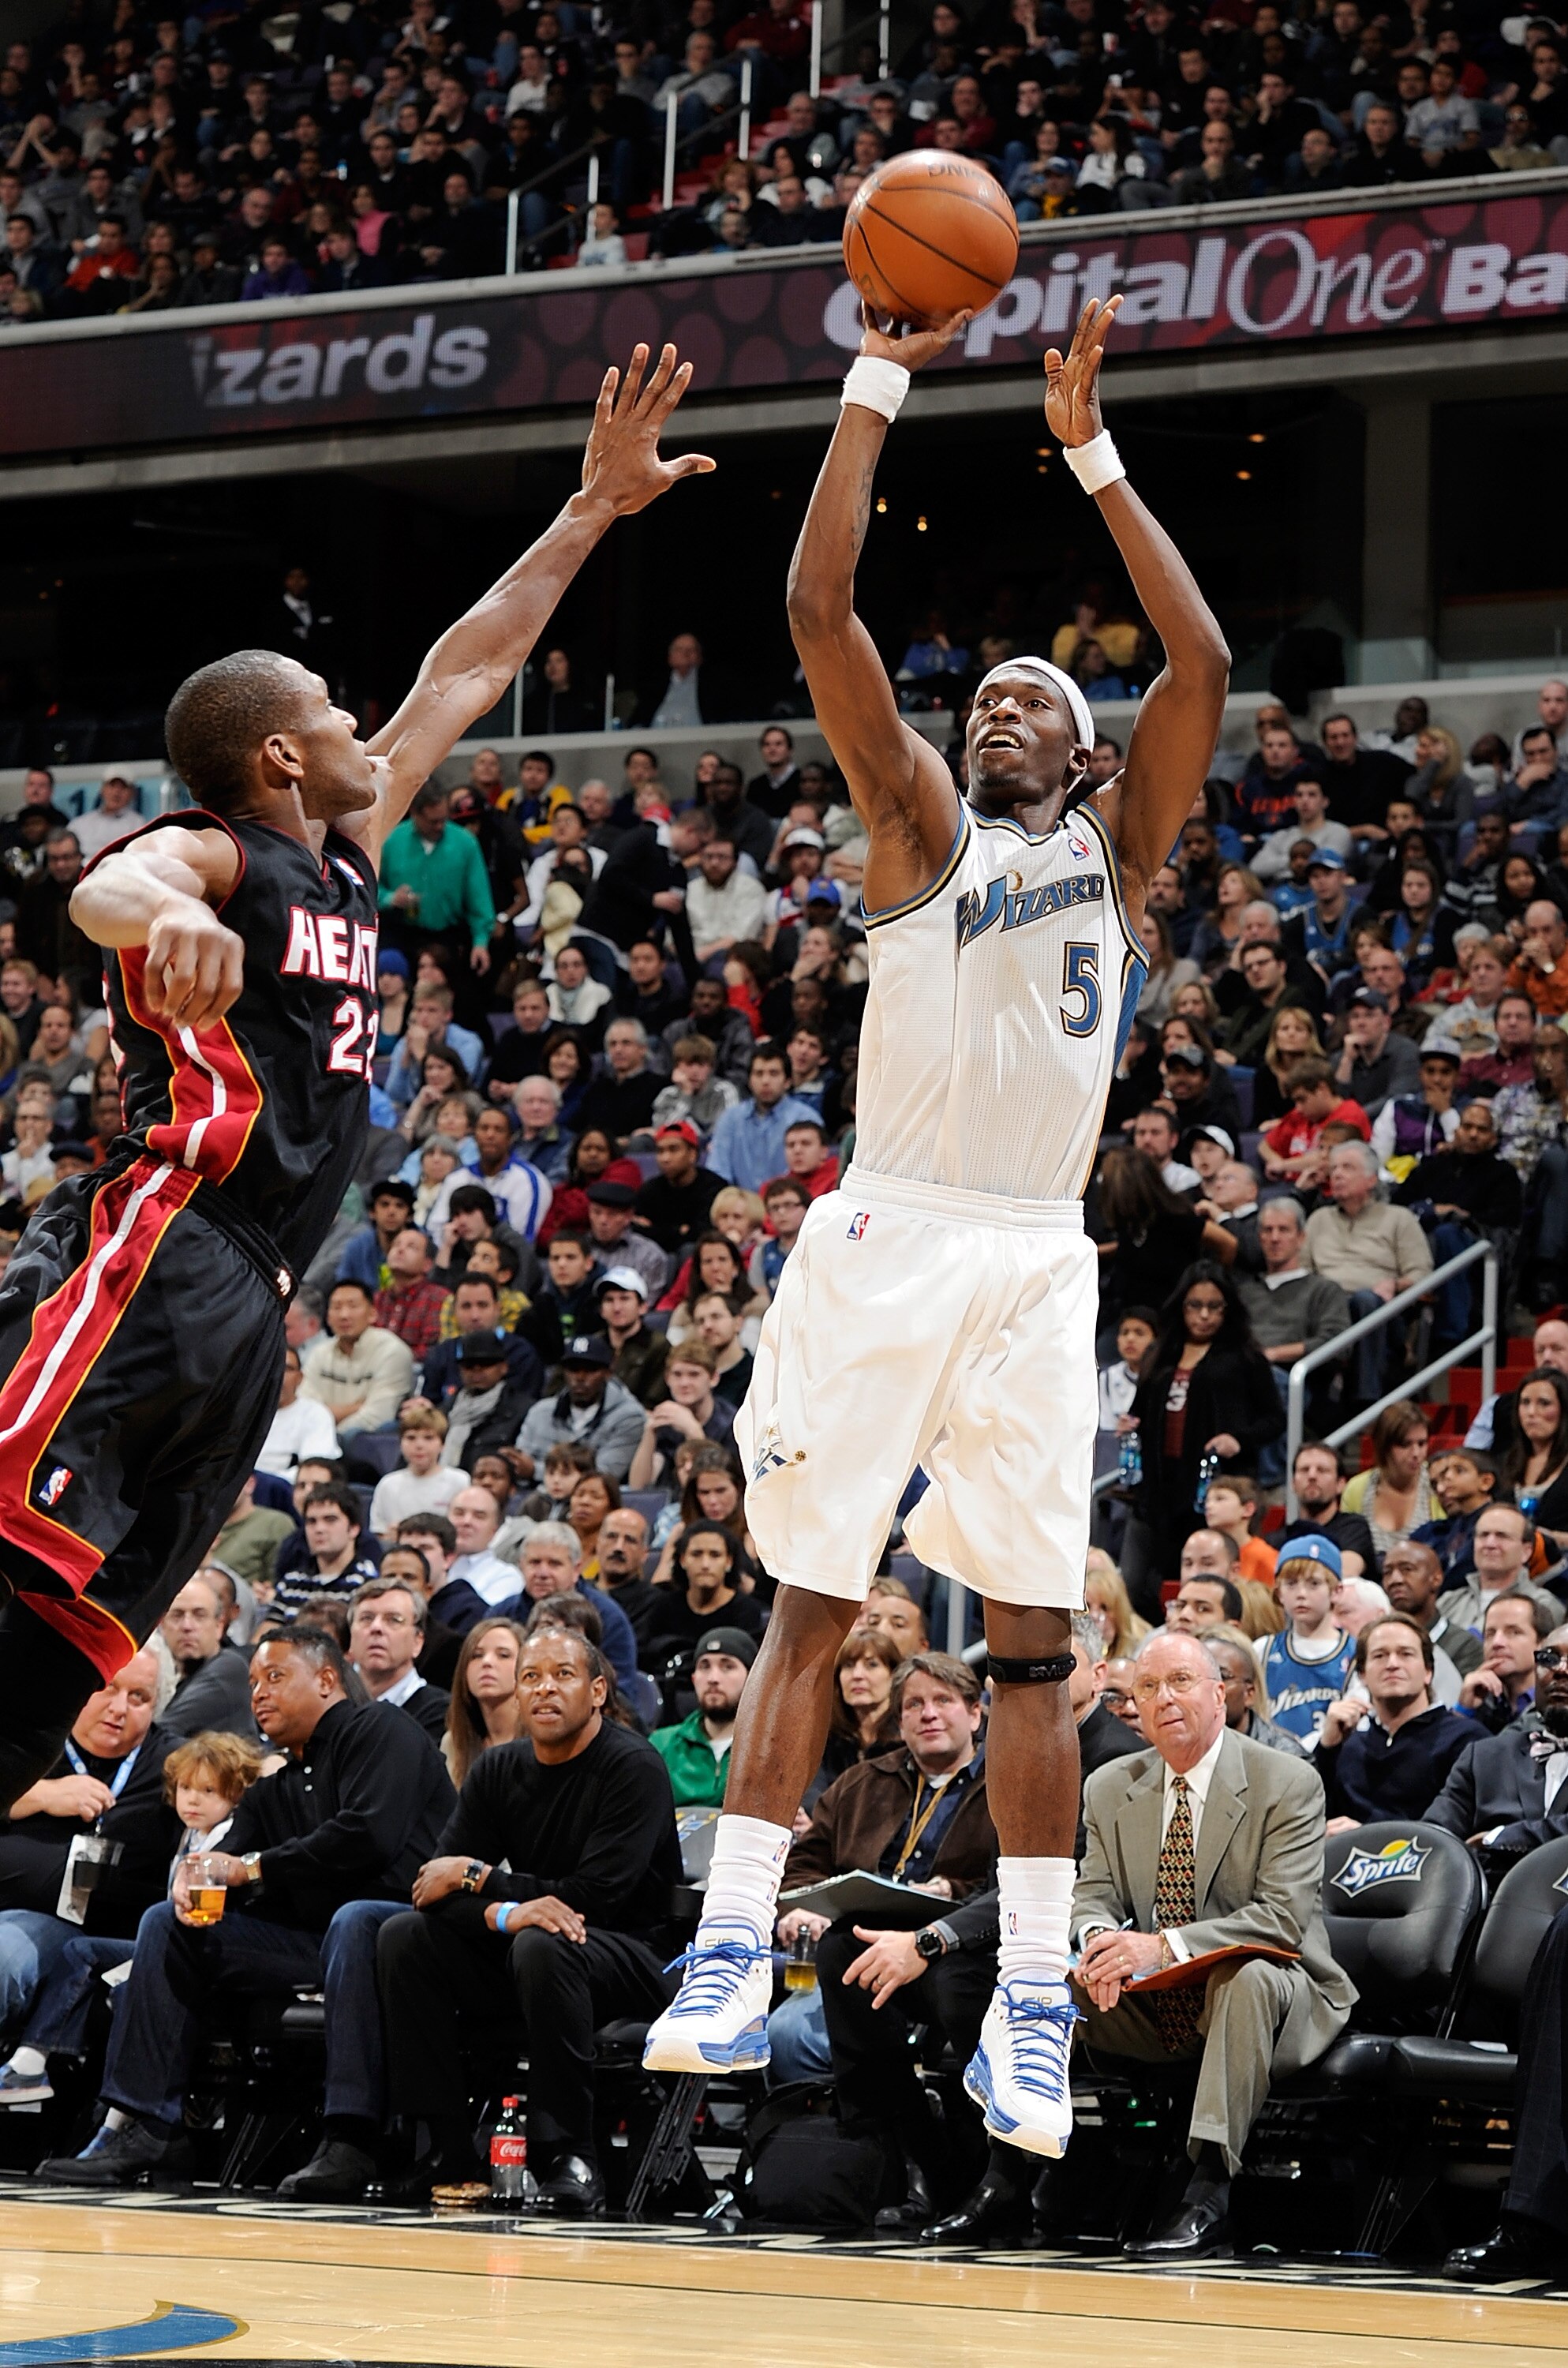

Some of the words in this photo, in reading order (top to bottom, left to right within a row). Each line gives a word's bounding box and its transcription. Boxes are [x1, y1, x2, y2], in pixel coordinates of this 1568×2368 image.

[281, 906, 379, 993] HEAT
[1058, 941, 1102, 1039] 5
[1342, 1848, 1420, 1891] Sprite
